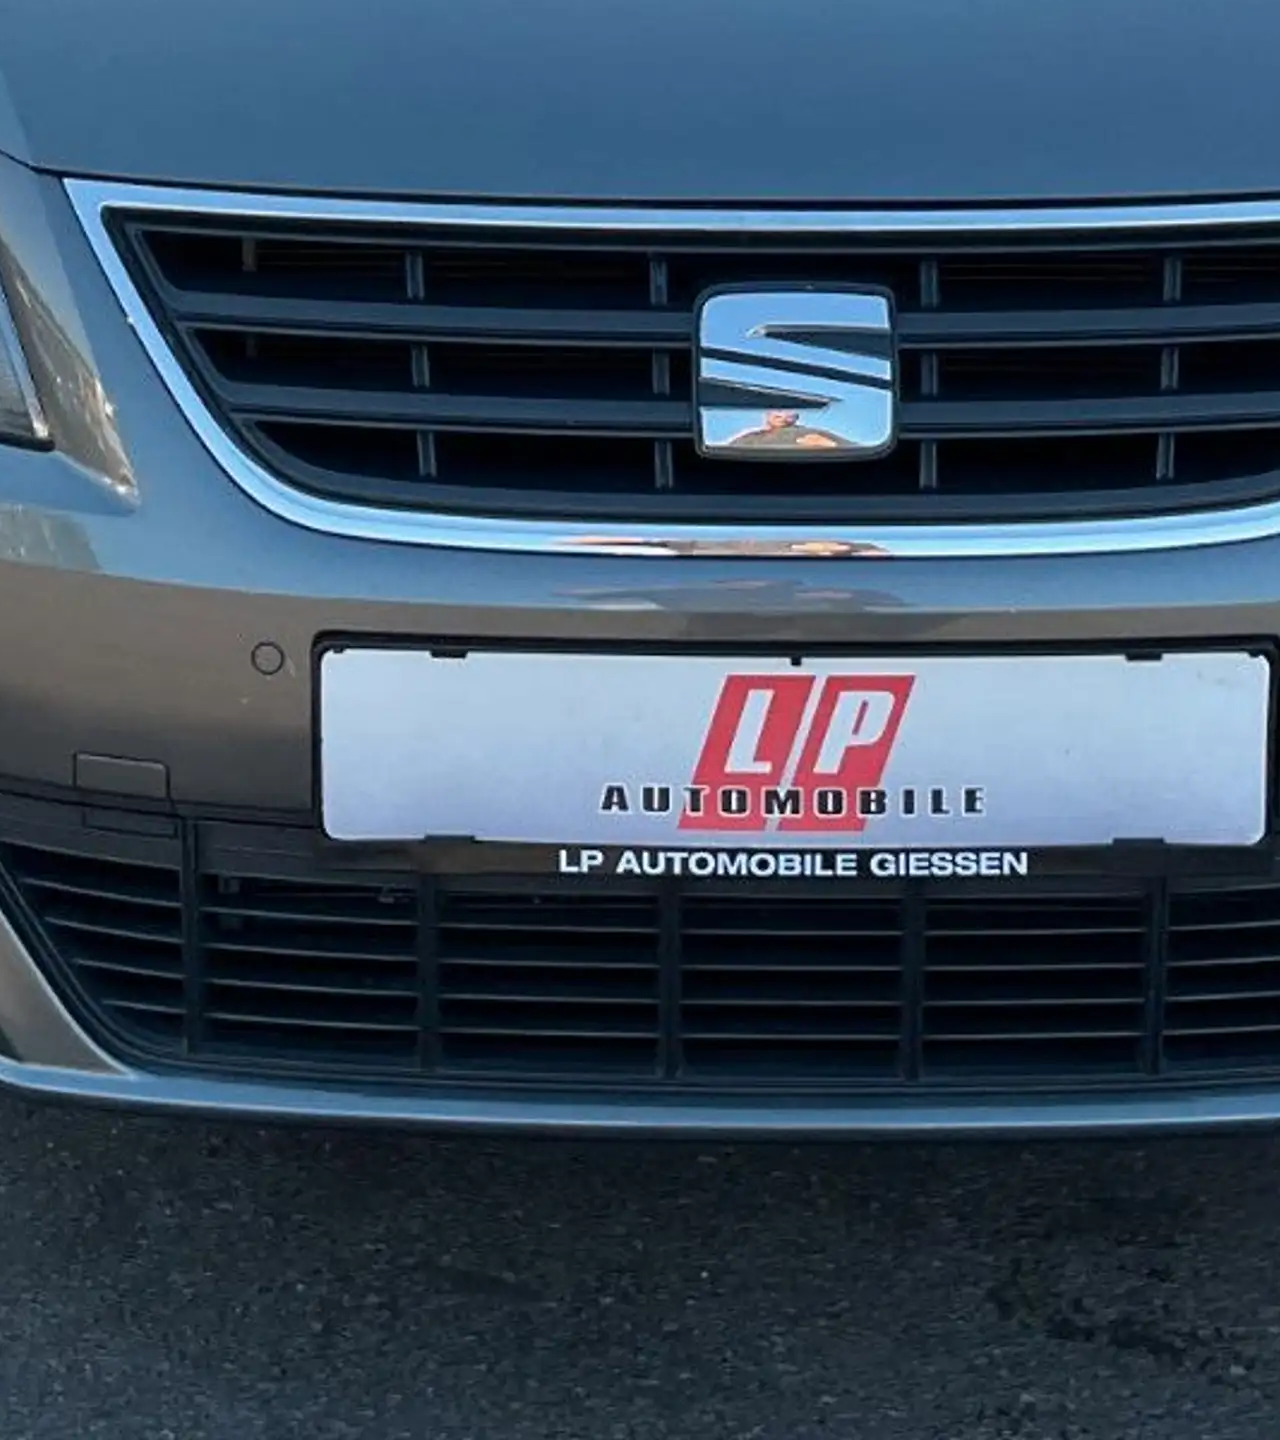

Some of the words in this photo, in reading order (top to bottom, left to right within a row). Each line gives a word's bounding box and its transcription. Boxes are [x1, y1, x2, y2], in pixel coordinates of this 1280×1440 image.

[600, 783, 988, 817] AUTOMOBILE
[557, 849, 604, 874] LP
[616, 851, 858, 878] AUTOMOBILE
[869, 851, 1028, 878] GIESSEN
